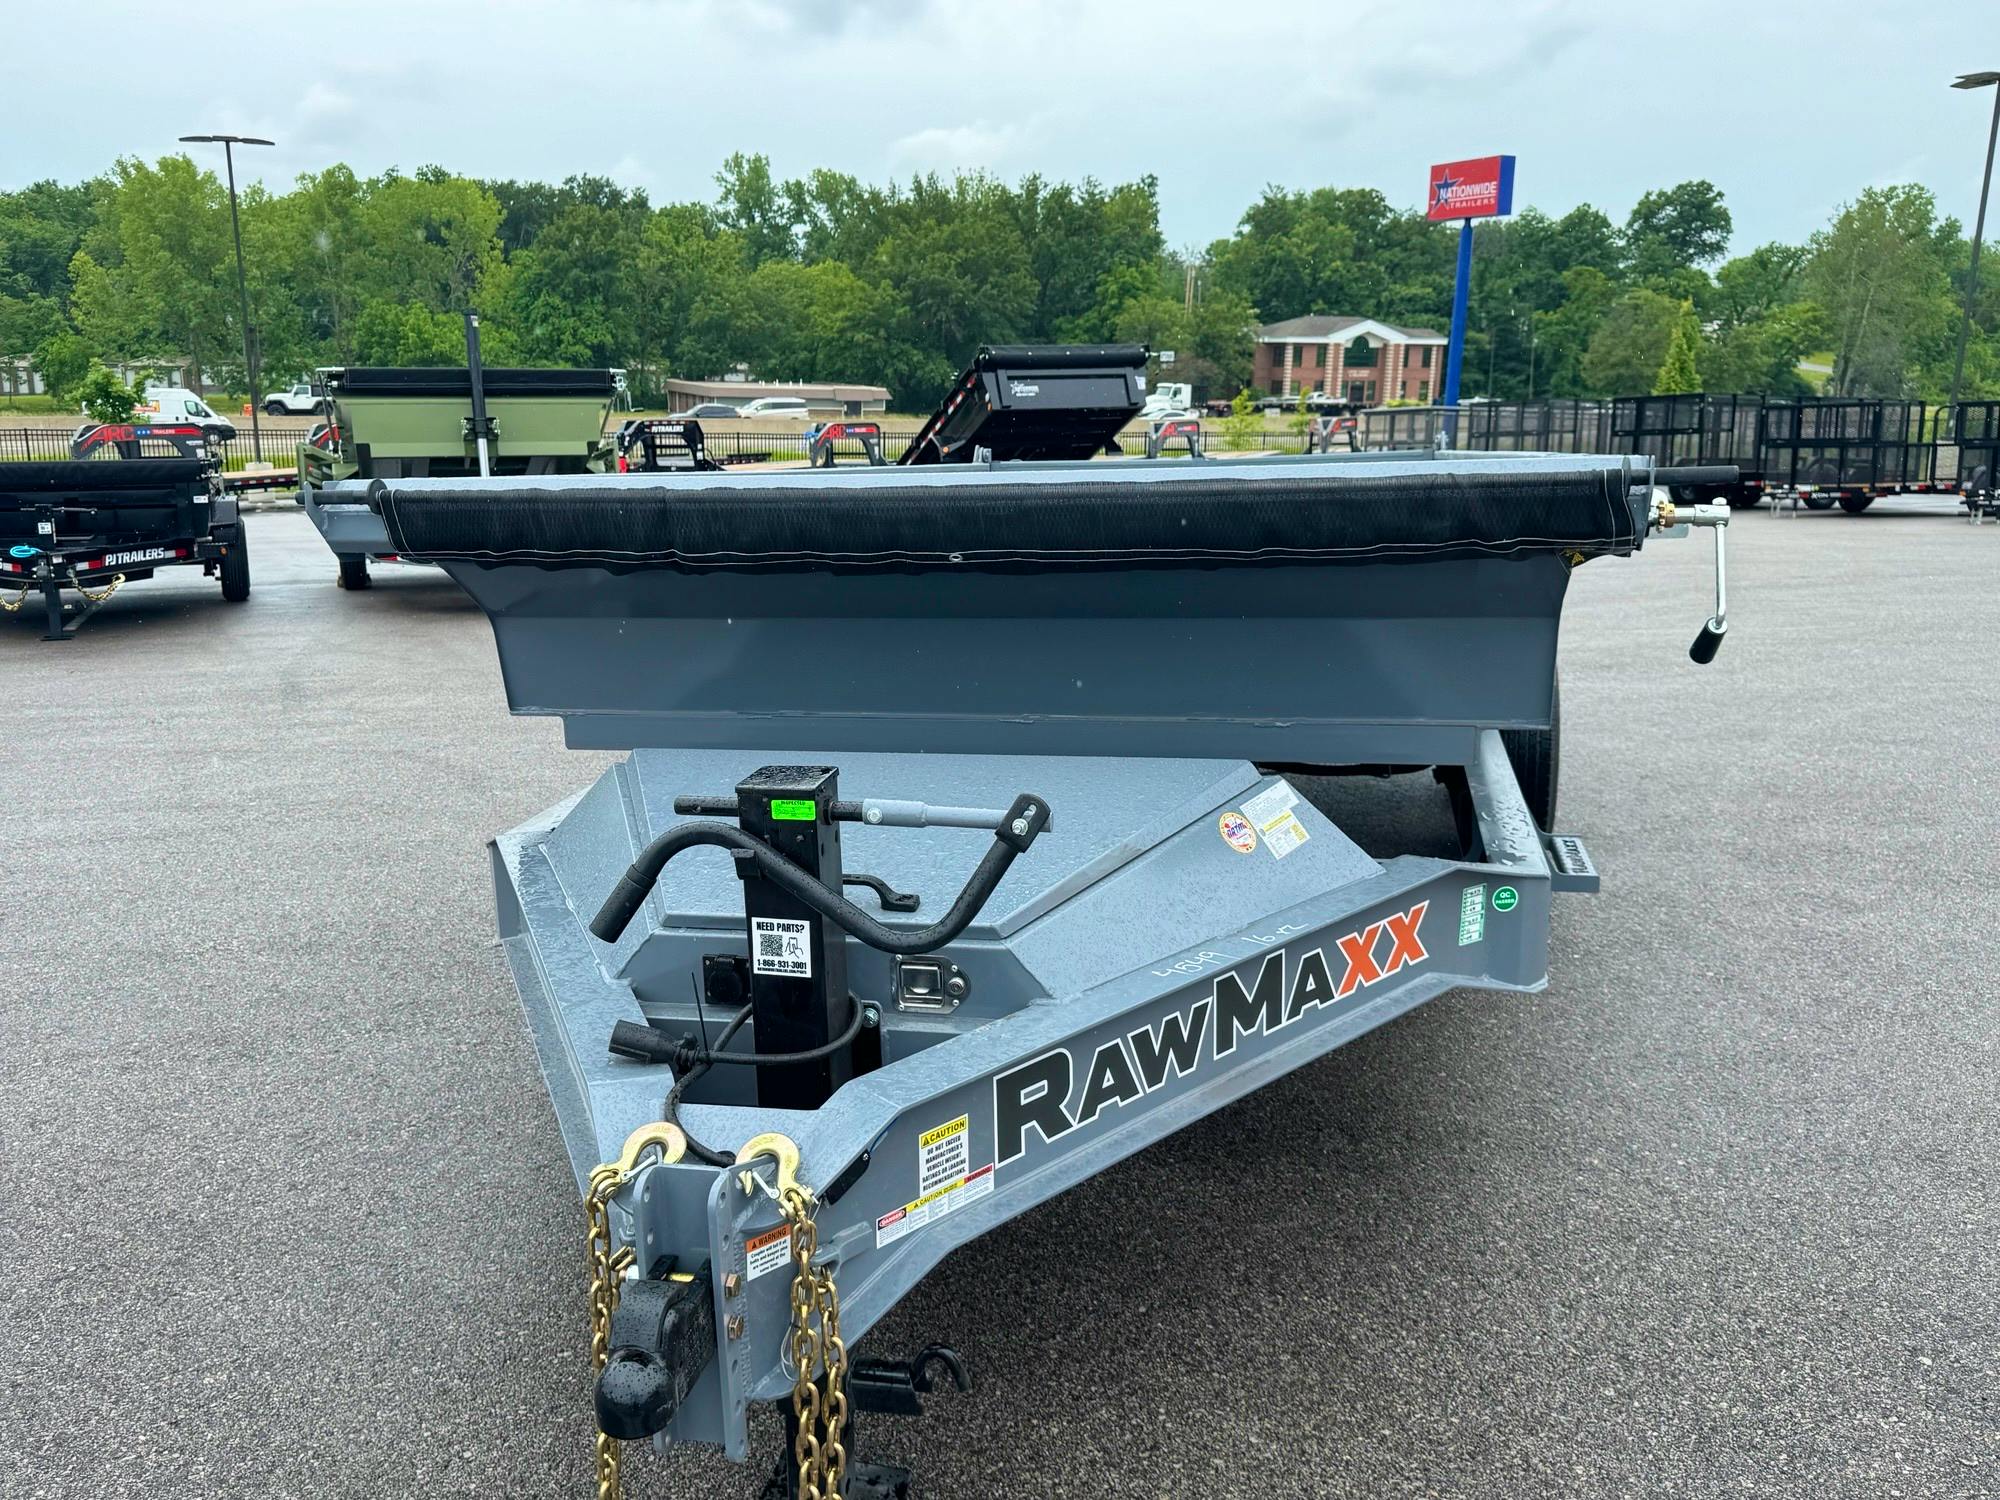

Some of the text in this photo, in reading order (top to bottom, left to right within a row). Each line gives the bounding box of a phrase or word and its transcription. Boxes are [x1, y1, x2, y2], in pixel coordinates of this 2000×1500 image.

[1440, 181, 1497, 200] NATIONWIDE
[1450, 198, 1495, 209] TRAILERS
[95, 426, 135, 441] ARC
[756, 921, 805, 934] NEED PARTS?
[1240, 934, 1275, 946] 16
[757, 959, 807, 970] 1-866-931-3001
[930, 1120, 965, 1143] CAUTION
[919, 1190, 943, 1205] CAUTION
[759, 1227, 787, 1246] WARNING
